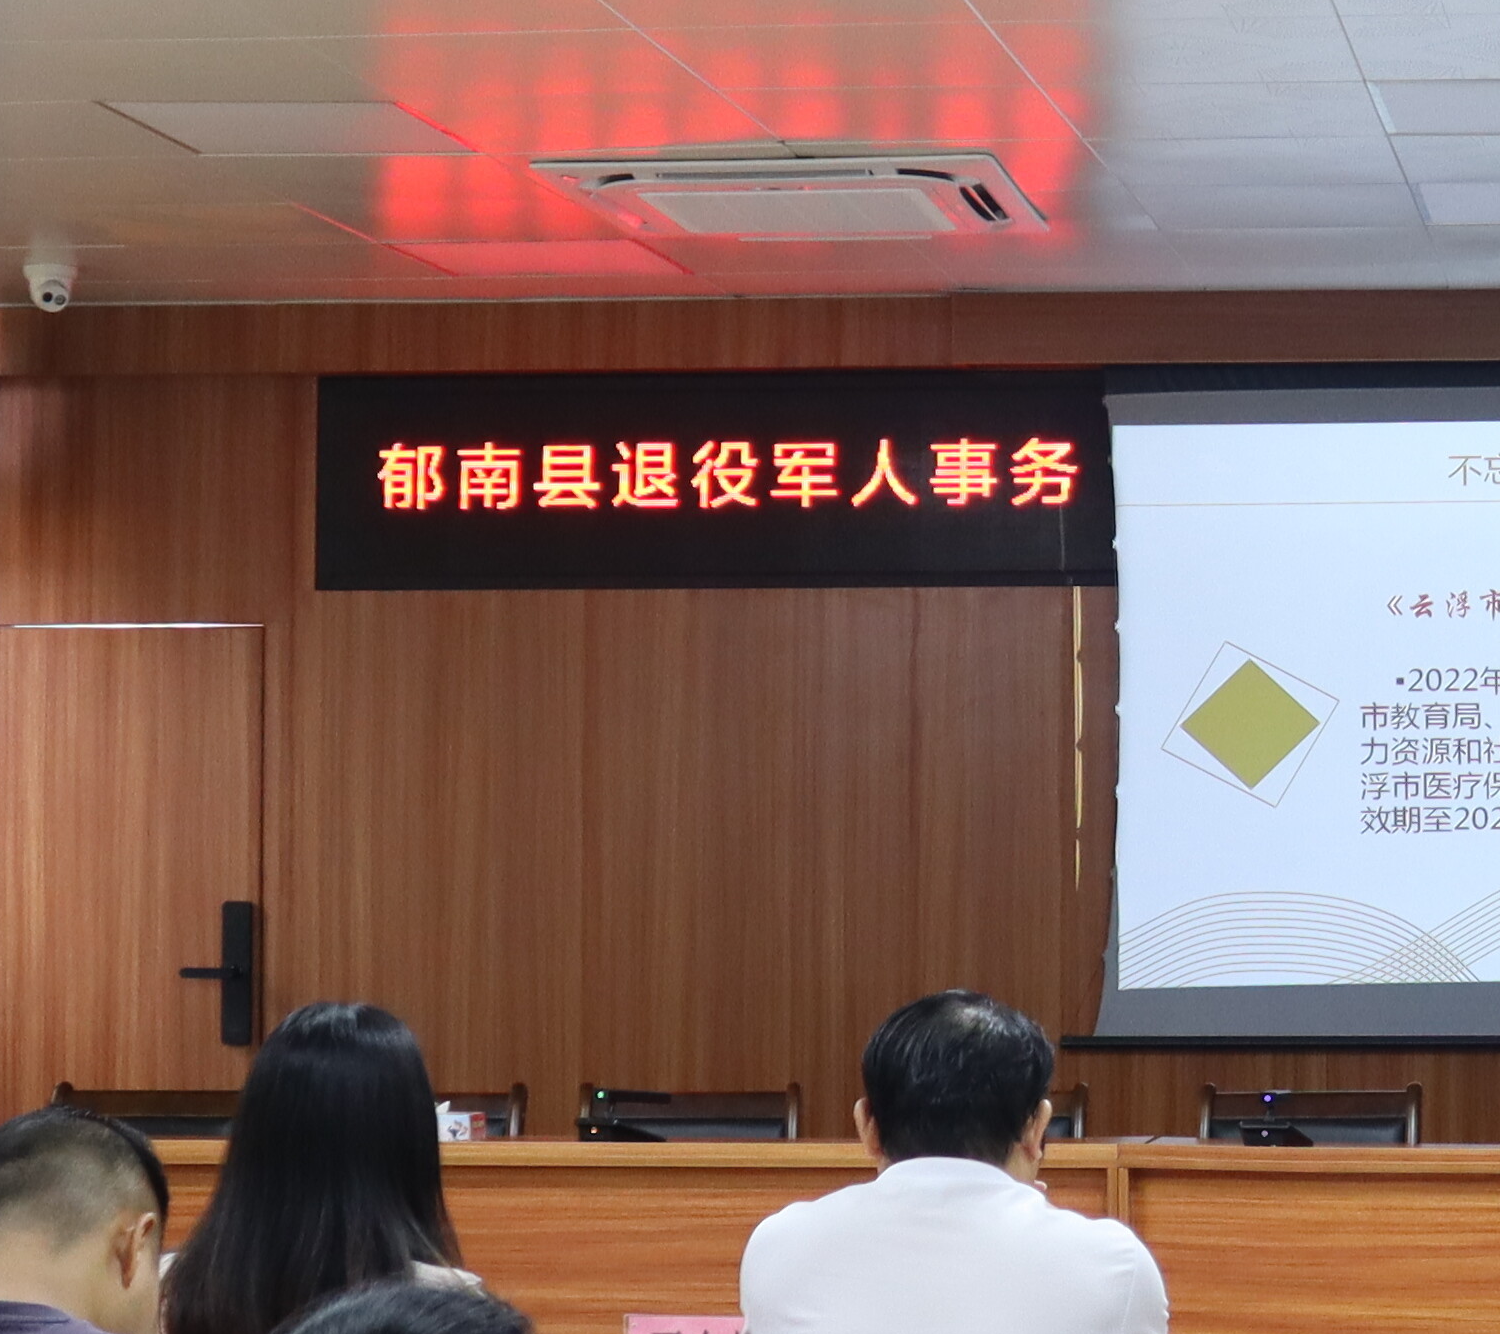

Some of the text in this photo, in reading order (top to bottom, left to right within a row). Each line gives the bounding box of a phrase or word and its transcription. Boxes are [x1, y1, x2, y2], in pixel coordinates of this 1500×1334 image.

[376, 437, 1080, 511] 郁南县退役军人事务
